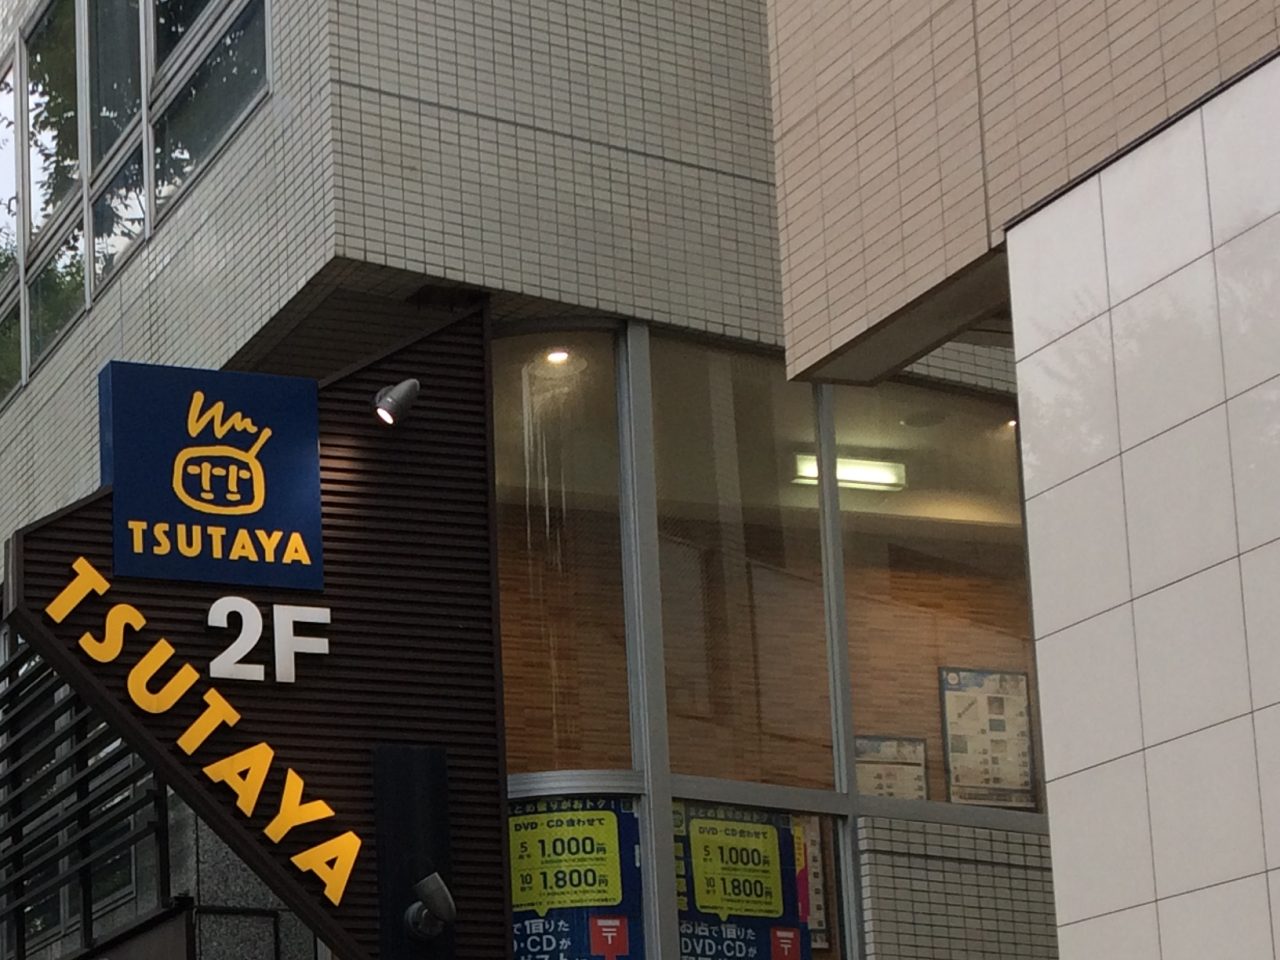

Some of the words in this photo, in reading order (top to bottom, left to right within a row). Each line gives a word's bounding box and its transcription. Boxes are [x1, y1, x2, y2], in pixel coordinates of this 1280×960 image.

[128, 520, 312, 566] TSUTAYA
[206, 596, 331, 683] 2F
[44, 556, 363, 907] TSUTAYA
[520, 841, 528, 852] 5
[703, 845, 711, 856] 5
[520, 873, 532, 885] 10
[680, 920, 756, 940] お店で借りた
